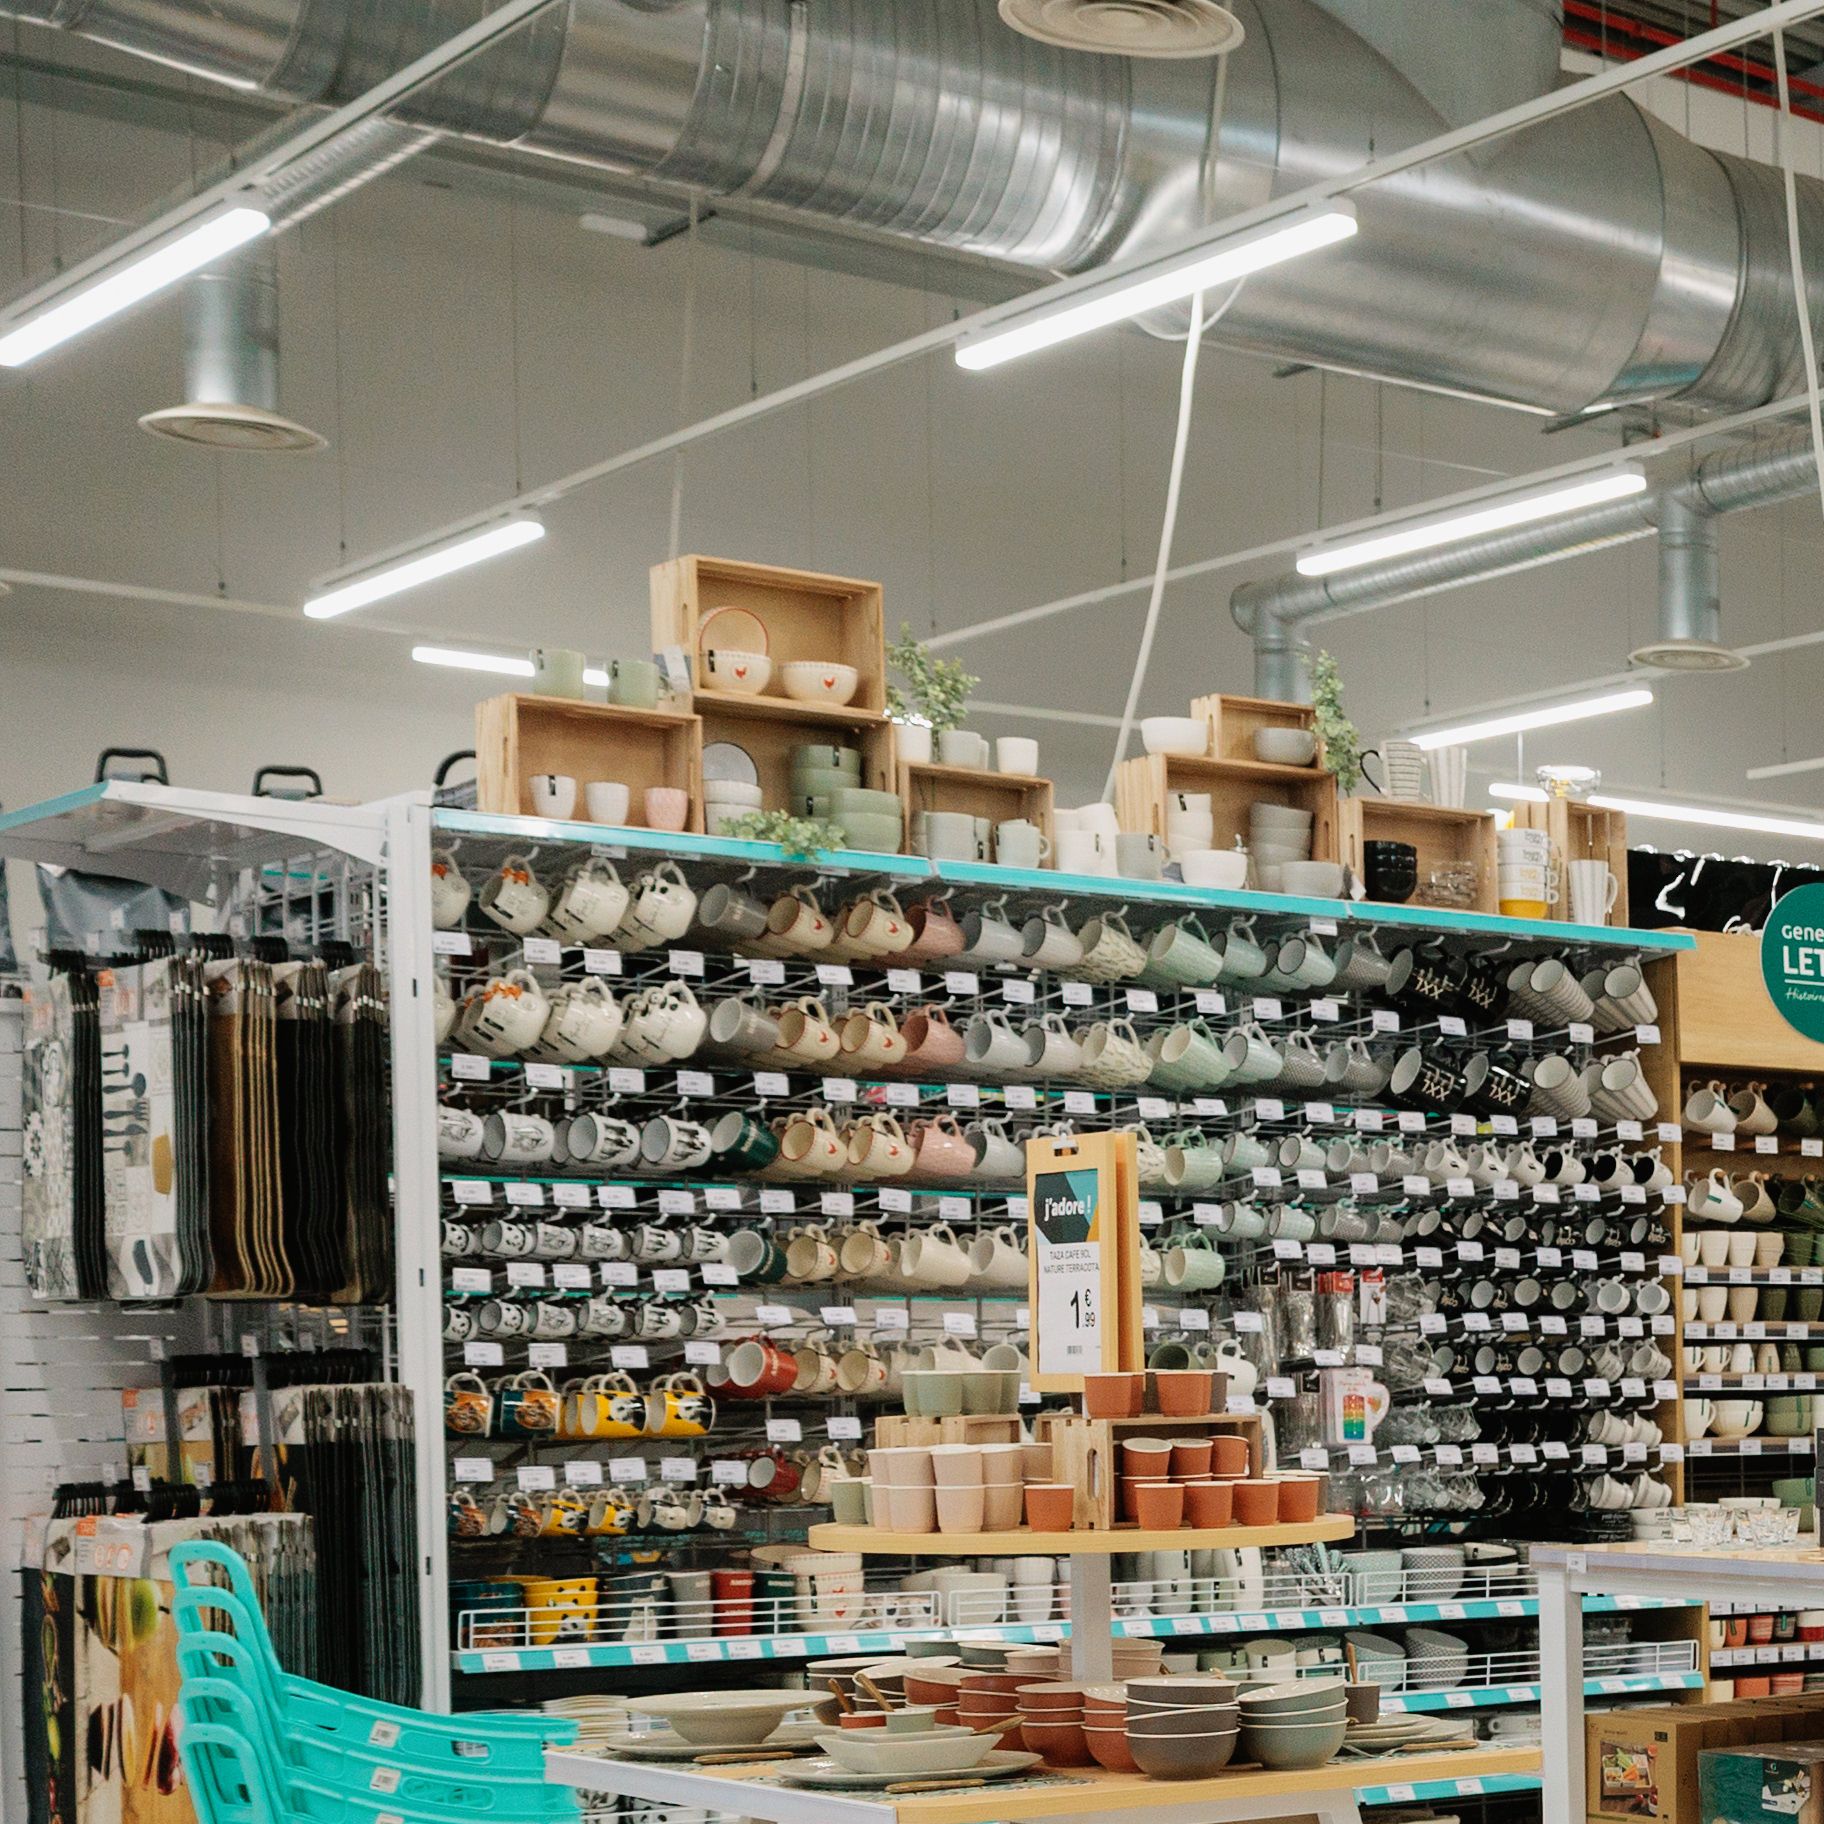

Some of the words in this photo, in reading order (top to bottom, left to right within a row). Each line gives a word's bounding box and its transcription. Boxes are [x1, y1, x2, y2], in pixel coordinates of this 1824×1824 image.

[1044, 1198, 1085, 1222] j'adore
[1044, 1264, 1065, 1274] NATURE
[1070, 1290, 1080, 1329] 1
[1084, 1289, 1092, 1307] €
